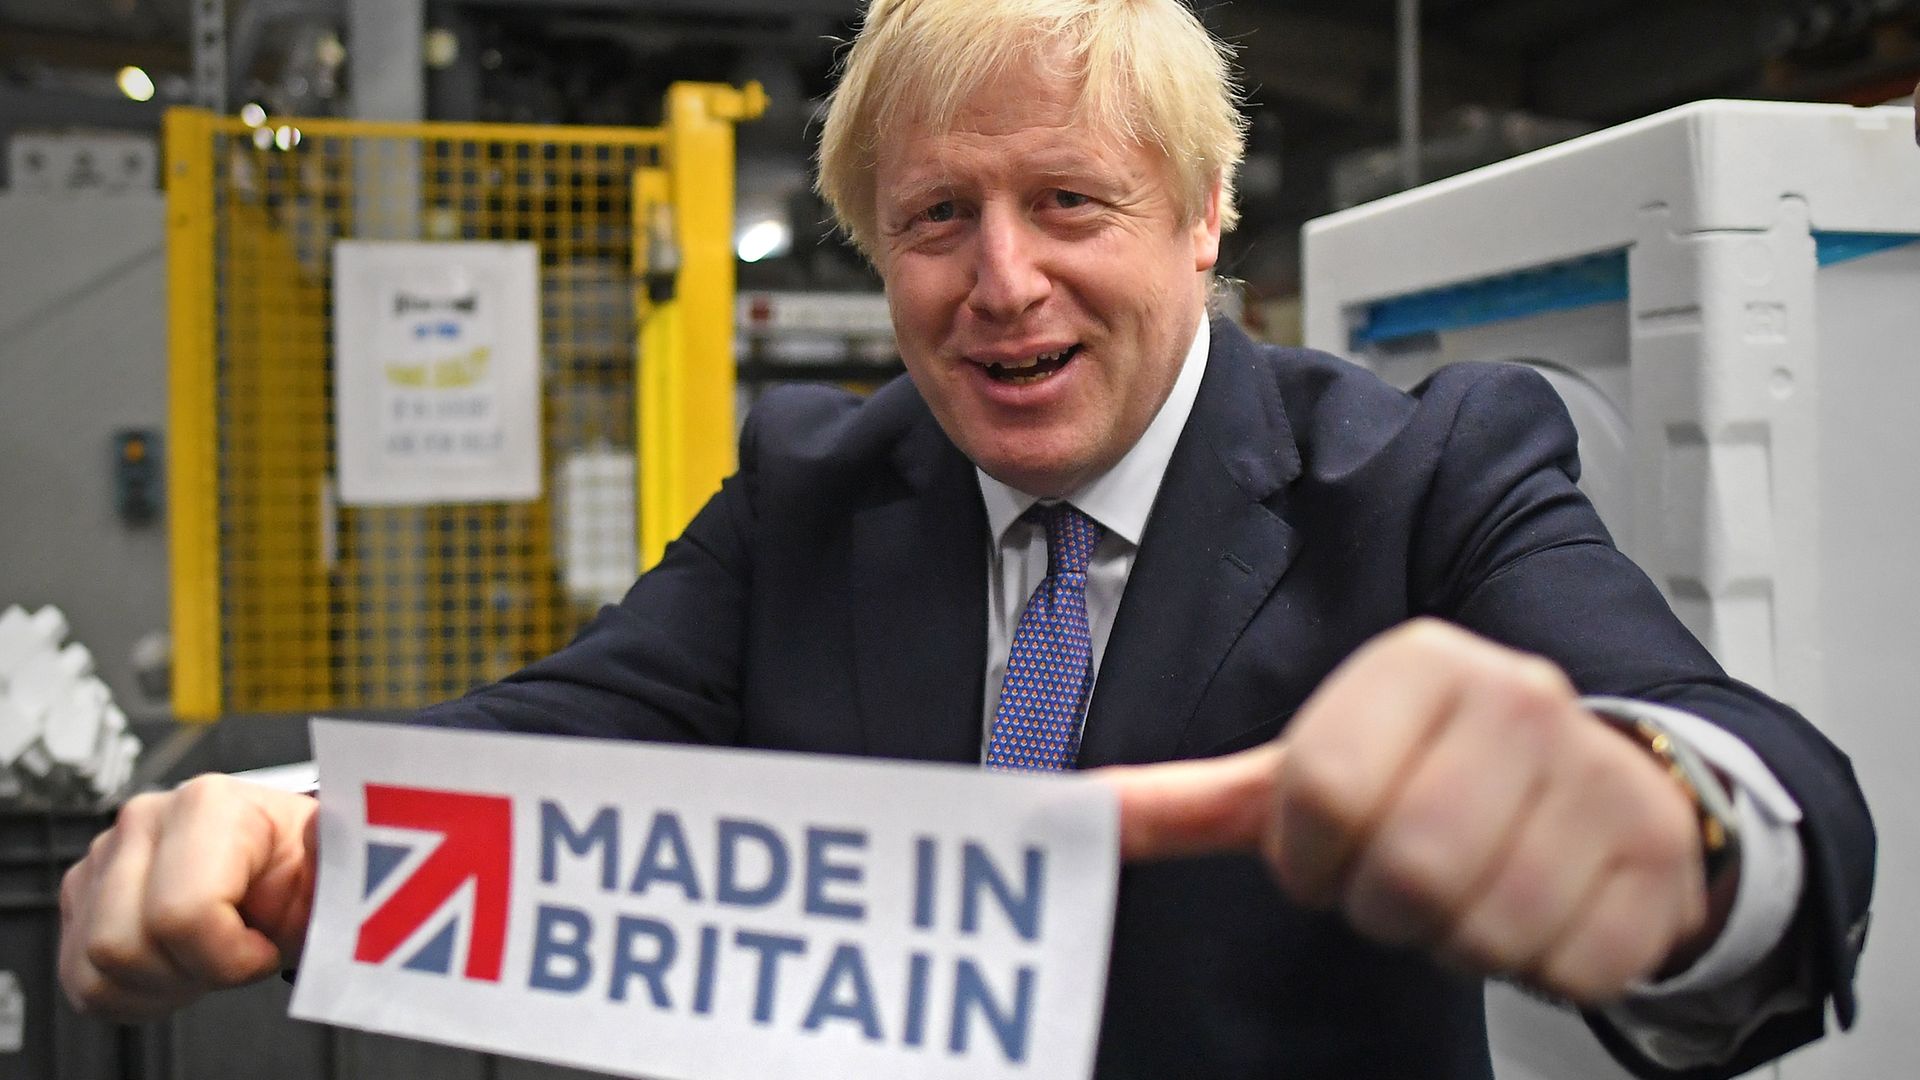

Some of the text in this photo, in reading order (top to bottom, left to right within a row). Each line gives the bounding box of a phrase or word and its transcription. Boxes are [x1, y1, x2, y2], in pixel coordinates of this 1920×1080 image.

[539, 800, 1047, 942] MADE IN
[527, 903, 1035, 1063] BRITAIN
